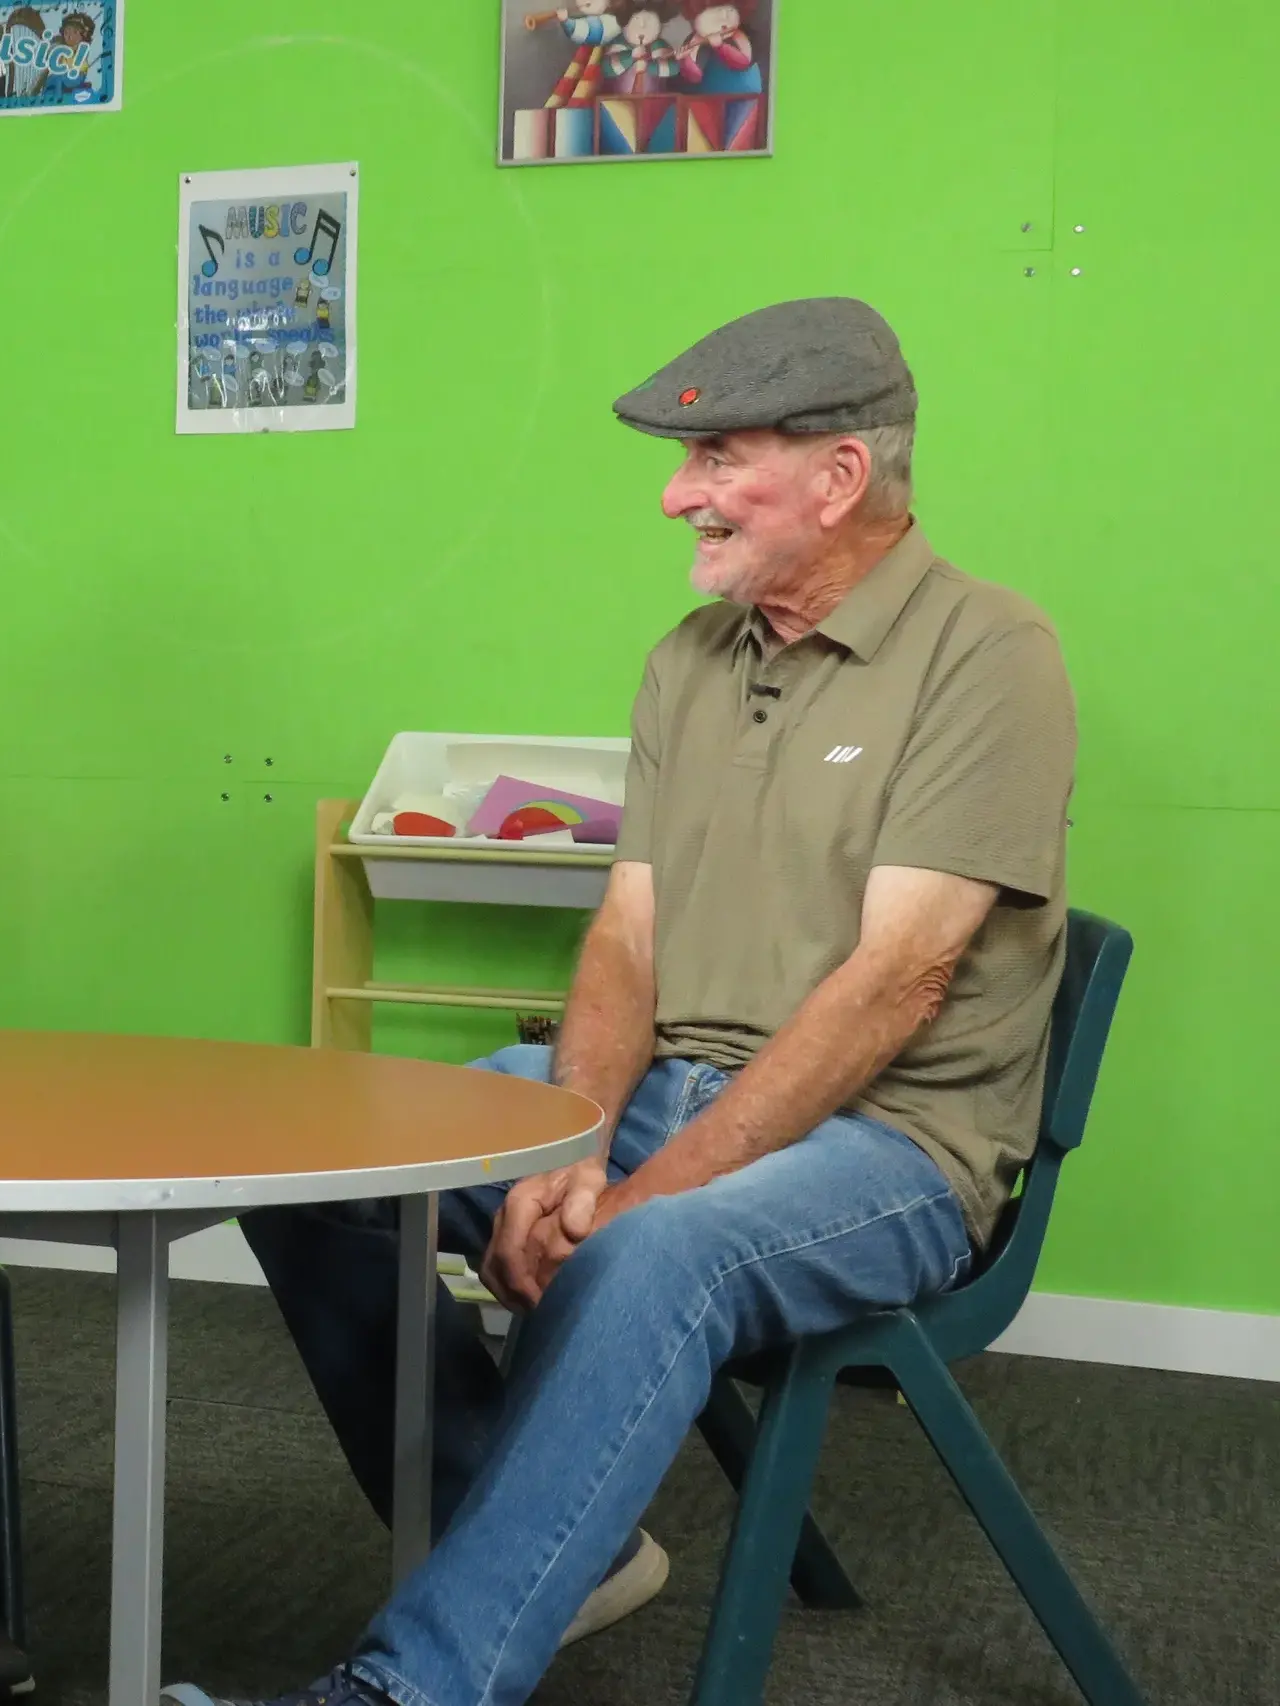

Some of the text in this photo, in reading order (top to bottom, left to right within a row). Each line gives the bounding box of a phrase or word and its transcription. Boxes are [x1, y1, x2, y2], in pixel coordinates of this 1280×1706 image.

[224, 201, 308, 240] MUSIC
[235, 249, 280, 269] is a
[193, 274, 294, 300] language
[194, 304, 228, 325] the
